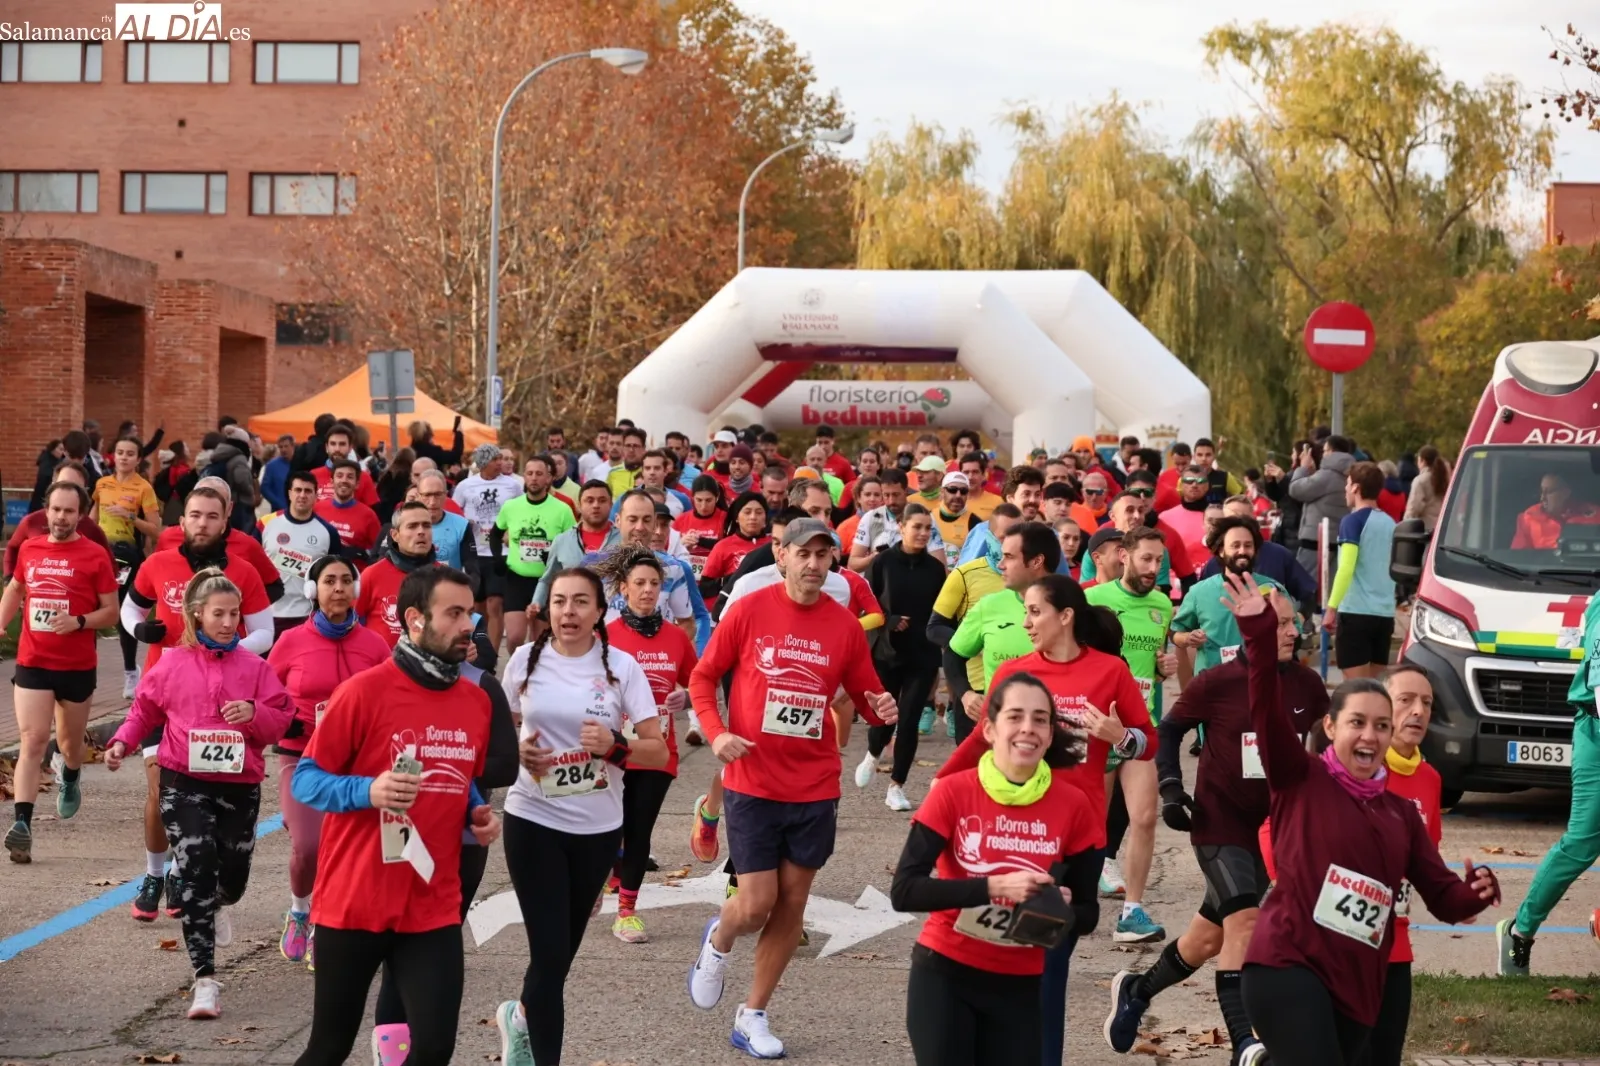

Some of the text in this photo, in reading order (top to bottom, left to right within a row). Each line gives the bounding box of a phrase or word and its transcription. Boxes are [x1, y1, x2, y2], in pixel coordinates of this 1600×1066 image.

[281, 556, 303, 571] 274
[785, 634, 821, 652] ¡Corre sin
[637, 650, 669, 661] ¡Corre sin
[778, 648, 830, 667] resistencias!
[768, 691, 825, 709] bedunia
[776, 706, 813, 726] 457
[190, 732, 244, 744] bedunia
[425, 725, 467, 743] ¡Corre sin
[200, 745, 235, 762] 424
[420, 743, 476, 762] resistencias!
[1520, 745, 1565, 763] 8063
[554, 763, 596, 787] 284
[996, 814, 1048, 836] ¡Corre sin
[986, 834, 1061, 855] resistencias!
[1328, 870, 1392, 906] bedunia
[1335, 894, 1381, 929] 432
